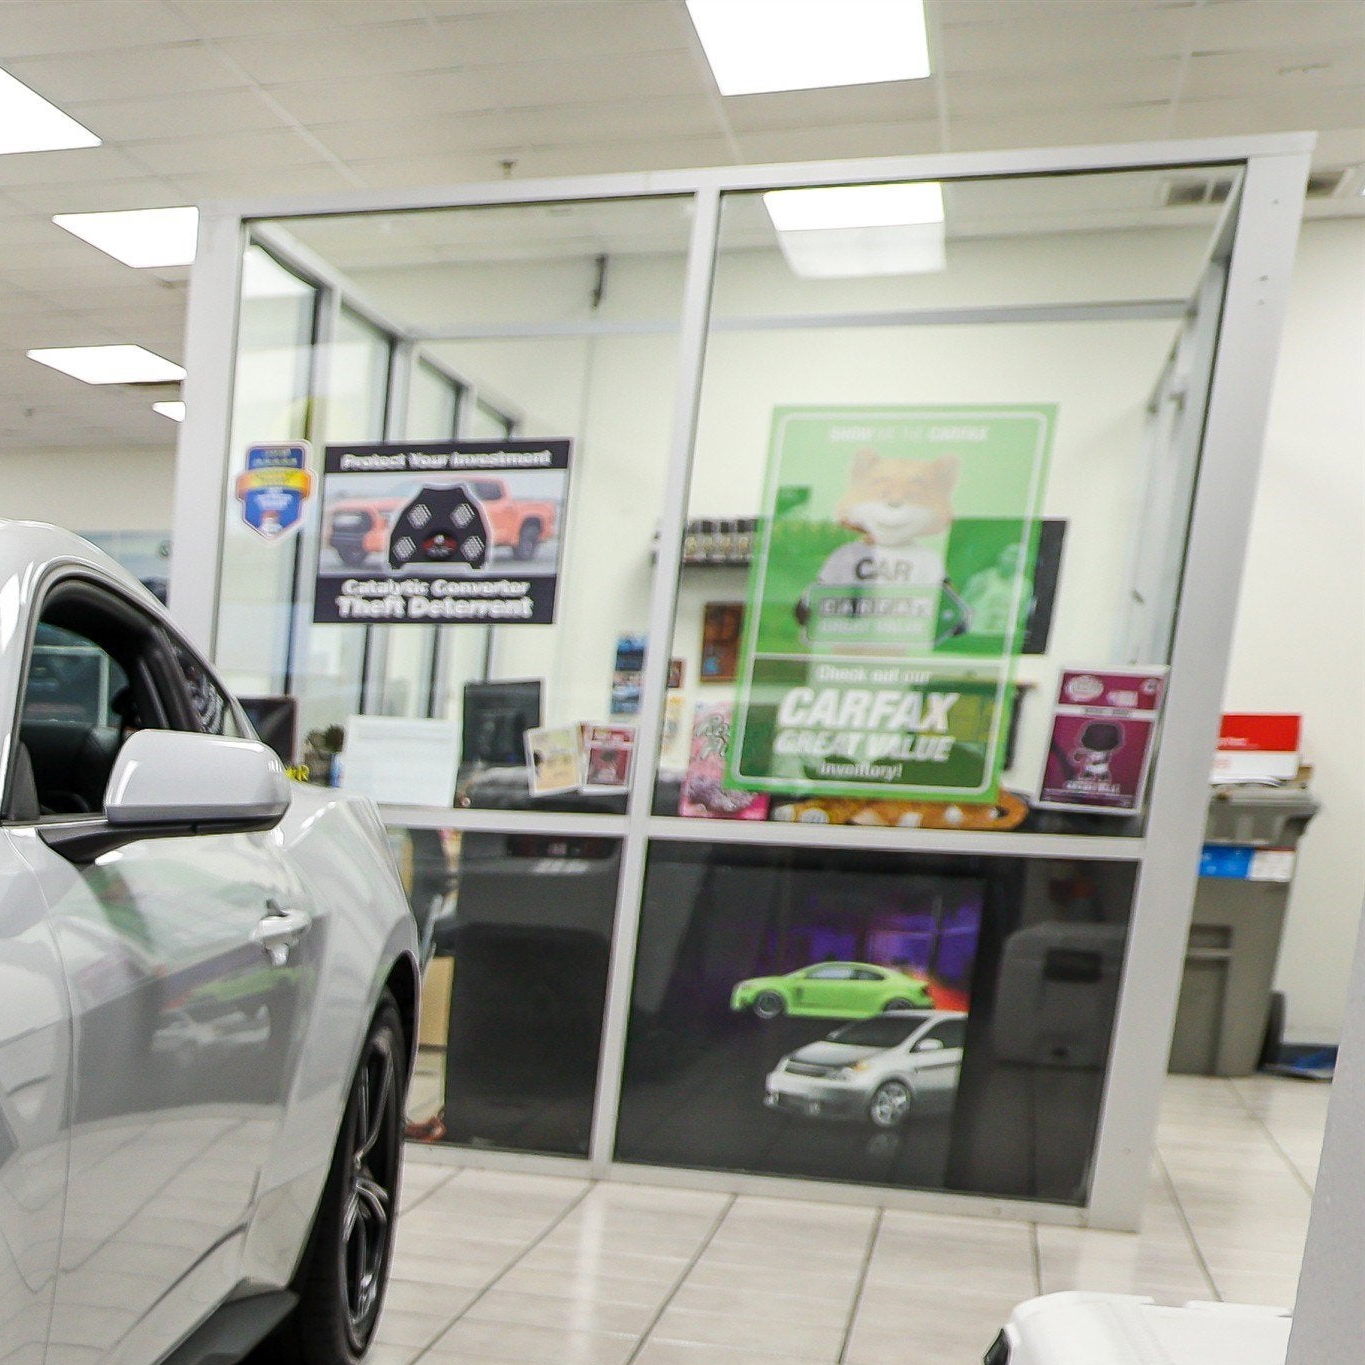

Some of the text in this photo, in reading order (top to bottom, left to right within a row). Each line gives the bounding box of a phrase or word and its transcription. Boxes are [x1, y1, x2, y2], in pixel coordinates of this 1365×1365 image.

[340, 450, 552, 470] Protect Your Investment
[855, 556, 914, 581] CAR
[342, 579, 530, 597] Catalytic Converter
[335, 595, 534, 618] Theft Deterrent
[819, 665, 867, 681] Check
[778, 687, 960, 733] CARFAX
[773, 729, 956, 762] GREAT VALUE
